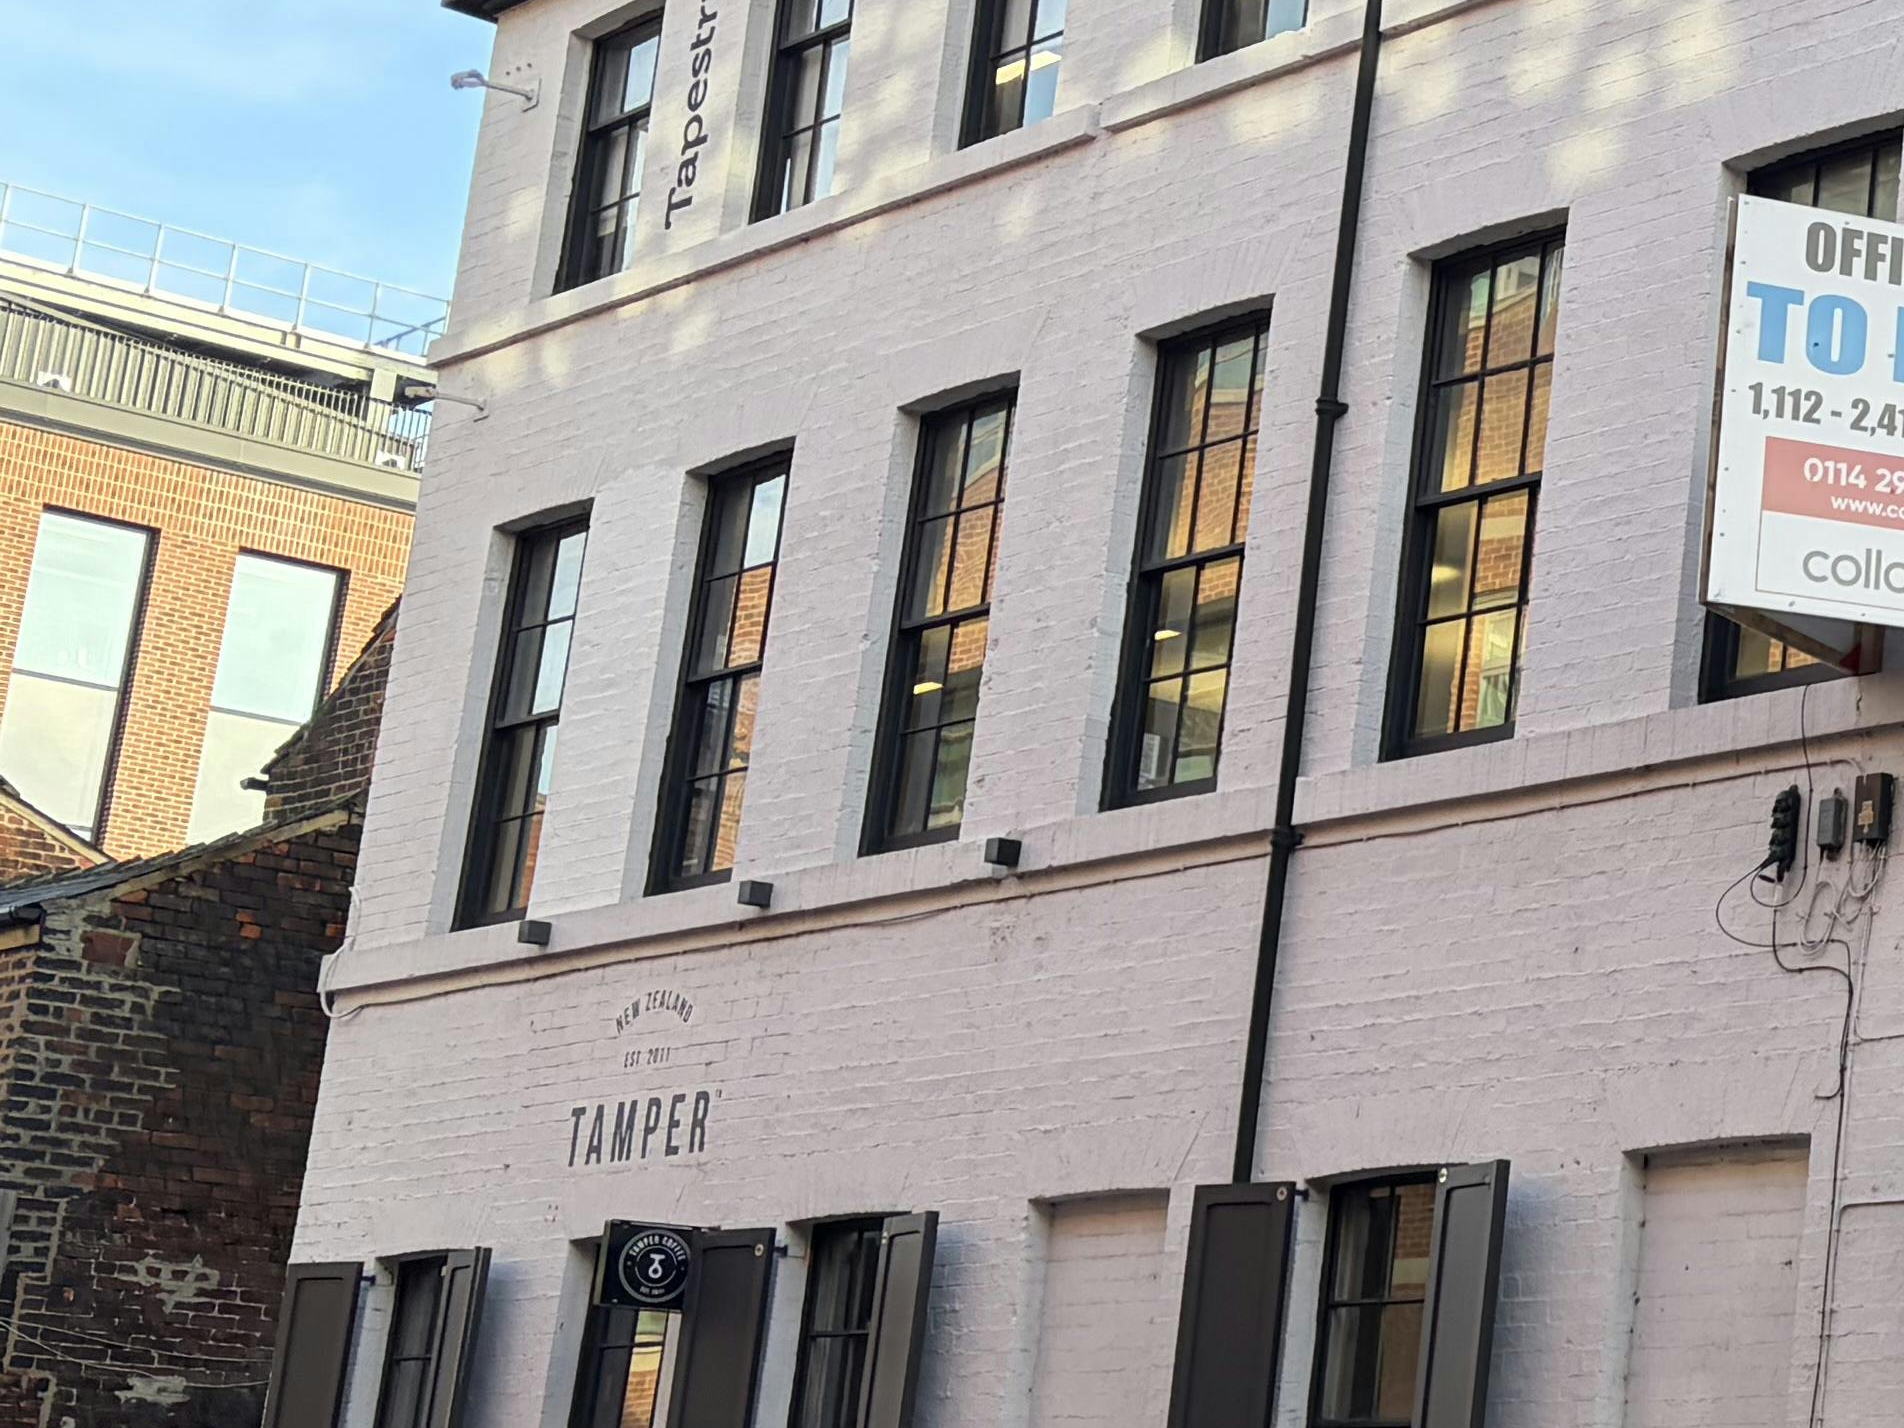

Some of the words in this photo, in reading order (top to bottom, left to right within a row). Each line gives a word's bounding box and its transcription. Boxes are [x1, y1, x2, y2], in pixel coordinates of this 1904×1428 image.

[1747, 281, 1868, 376] TO
[1748, 382, 1824, 425] 1,112
[1803, 457, 1866, 490] 0114
[615, 998, 641, 1034] NEW
[645, 989, 694, 1023] ZEALAND
[623, 1050, 642, 1068] EST
[646, 1046, 671, 1065] 2011
[568, 1090, 710, 1167] TAMPER
